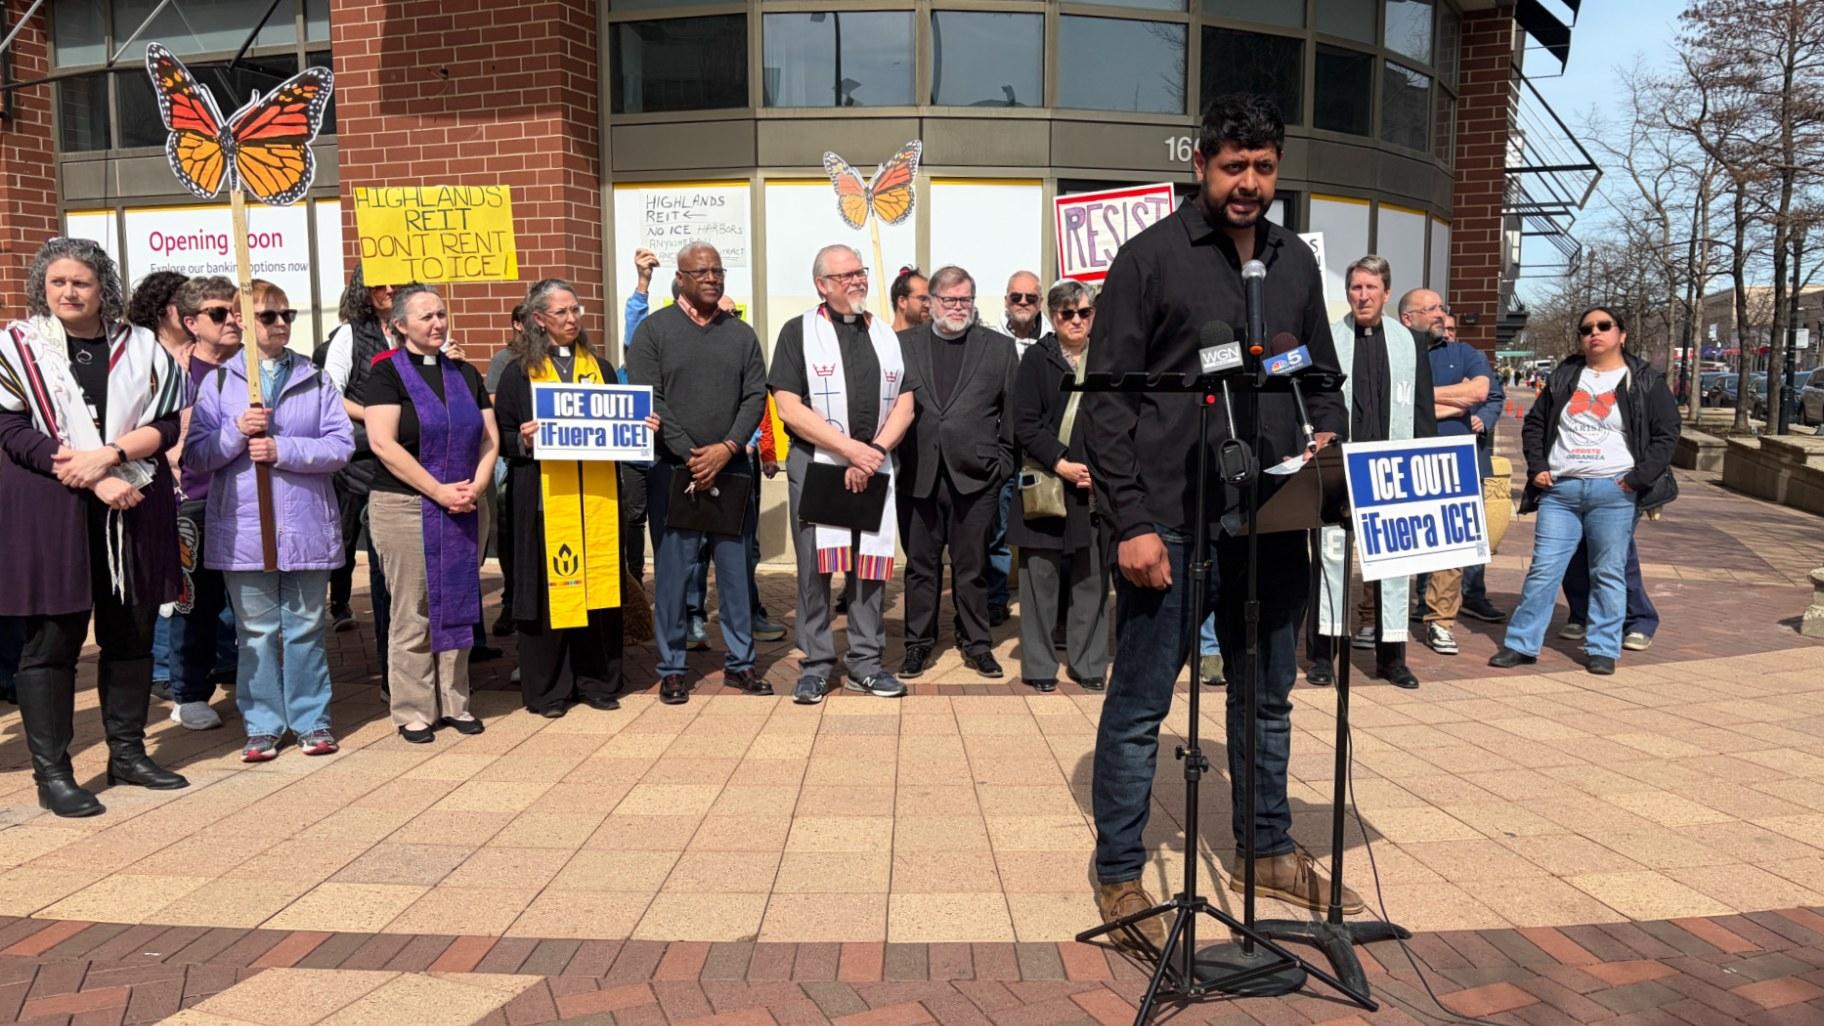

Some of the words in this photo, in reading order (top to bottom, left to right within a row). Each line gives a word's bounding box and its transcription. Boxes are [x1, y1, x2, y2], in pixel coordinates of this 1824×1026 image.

[1165, 136, 1199, 162] 16
[355, 186, 503, 208] HIGHLANDS
[646, 193, 725, 210] HIGHLANDS
[405, 208, 472, 231] REIT
[646, 210, 680, 223] REIT
[149, 229, 229, 256] Opening
[246, 231, 283, 249] oon
[440, 230, 507, 255] RENT
[647, 227, 665, 237] NO
[670, 225, 691, 235] ICE
[1064, 197, 1169, 272] RESIST
[188, 264, 205, 274] our
[207, 262, 238, 273] bankin
[250, 260, 286, 275] options
[288, 262, 309, 272] now
[401, 257, 443, 280] TO
[1202, 346, 1239, 363] WGN
[1288, 350, 1302, 365] 5
[553, 392, 585, 418] ICE
[590, 393, 634, 419] OUT!
[540, 422, 607, 448] ¡Fuera
[612, 423, 647, 448] ICE!
[1368, 456, 1408, 501] ICE
[1410, 452, 1462, 497] OUT!
[1361, 512, 1439, 556] ¡Fuera
[1440, 501, 1482, 545] ICE!
